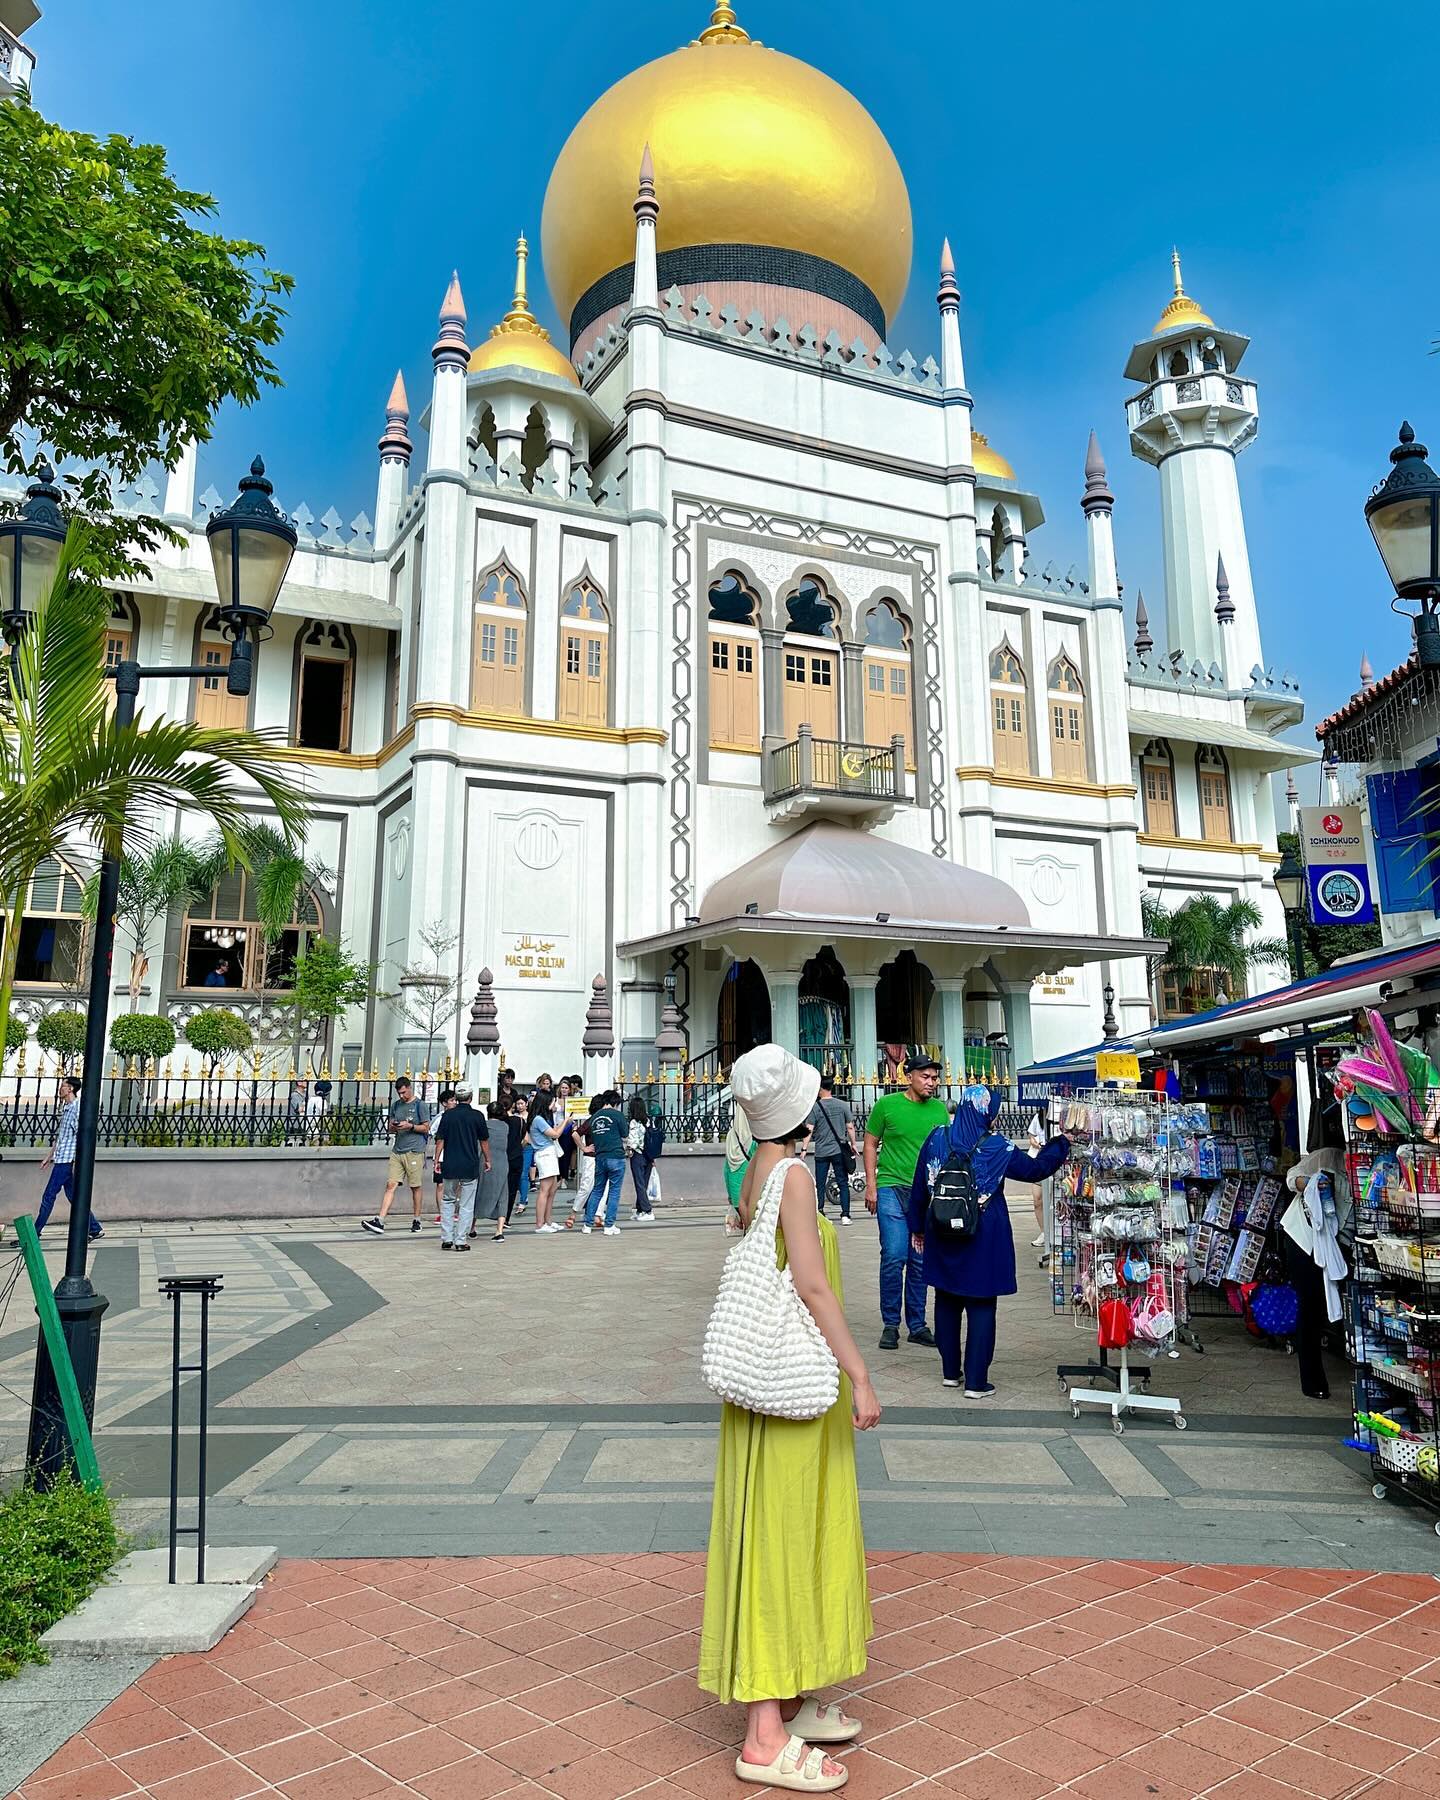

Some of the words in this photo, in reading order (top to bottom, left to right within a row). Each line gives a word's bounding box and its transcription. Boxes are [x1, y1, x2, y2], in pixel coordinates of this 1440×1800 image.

[1310, 837, 1360, 845] ICHIKOKUDO
[505, 955, 533, 967] MASJID
[537, 957, 565, 968] SULTAN
